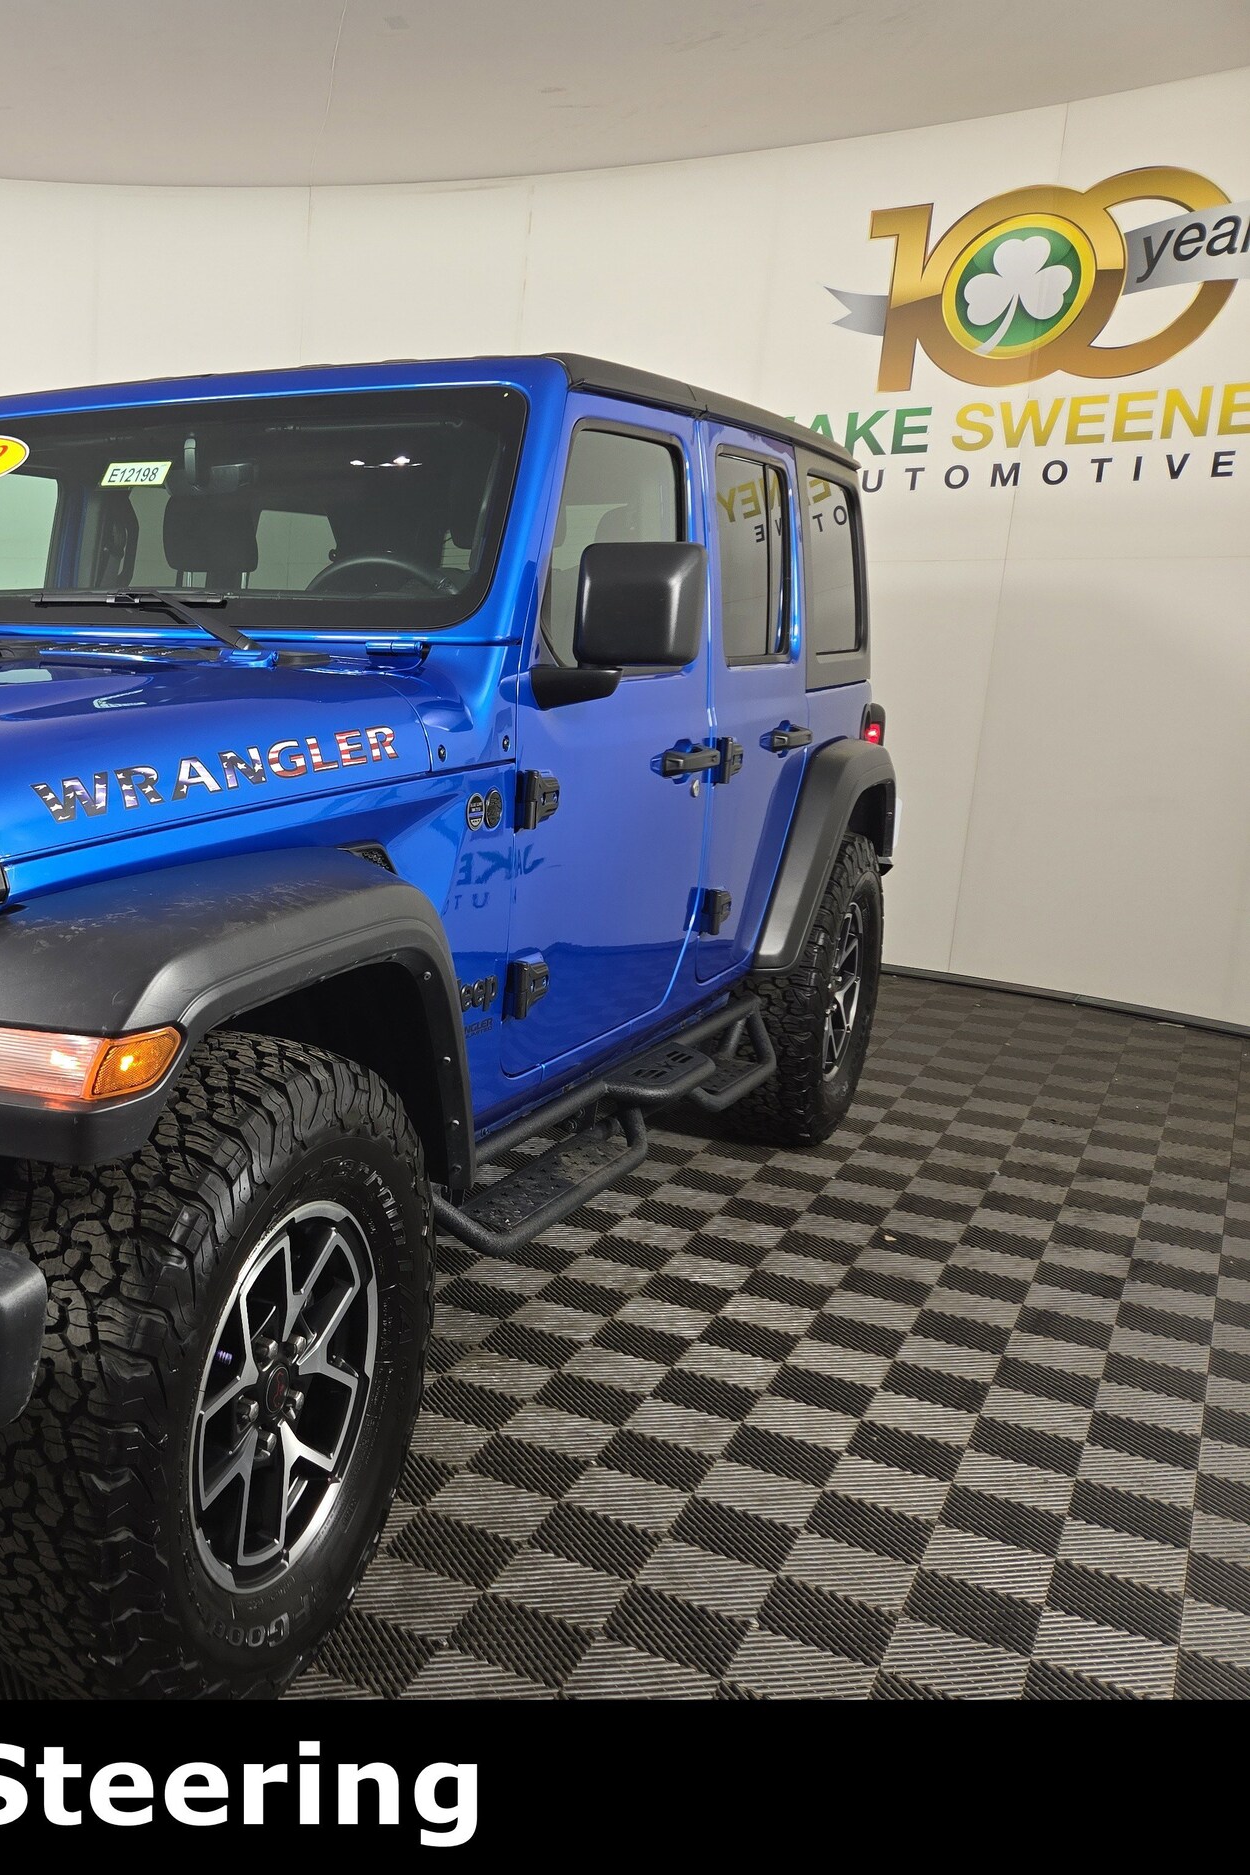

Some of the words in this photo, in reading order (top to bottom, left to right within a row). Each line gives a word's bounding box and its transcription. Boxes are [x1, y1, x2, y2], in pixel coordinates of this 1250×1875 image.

[1136, 215, 1250, 283] yea
[783, 406, 933, 457] AKE
[950, 382, 1250, 452] SWEENE
[107, 466, 160, 483] E12198
[861, 450, 1236, 493] UTOMOTIVE
[30, 725, 400, 824] WRANGLER
[457, 974, 498, 1013] eep
[464, 1017, 493, 1035] NGLER
